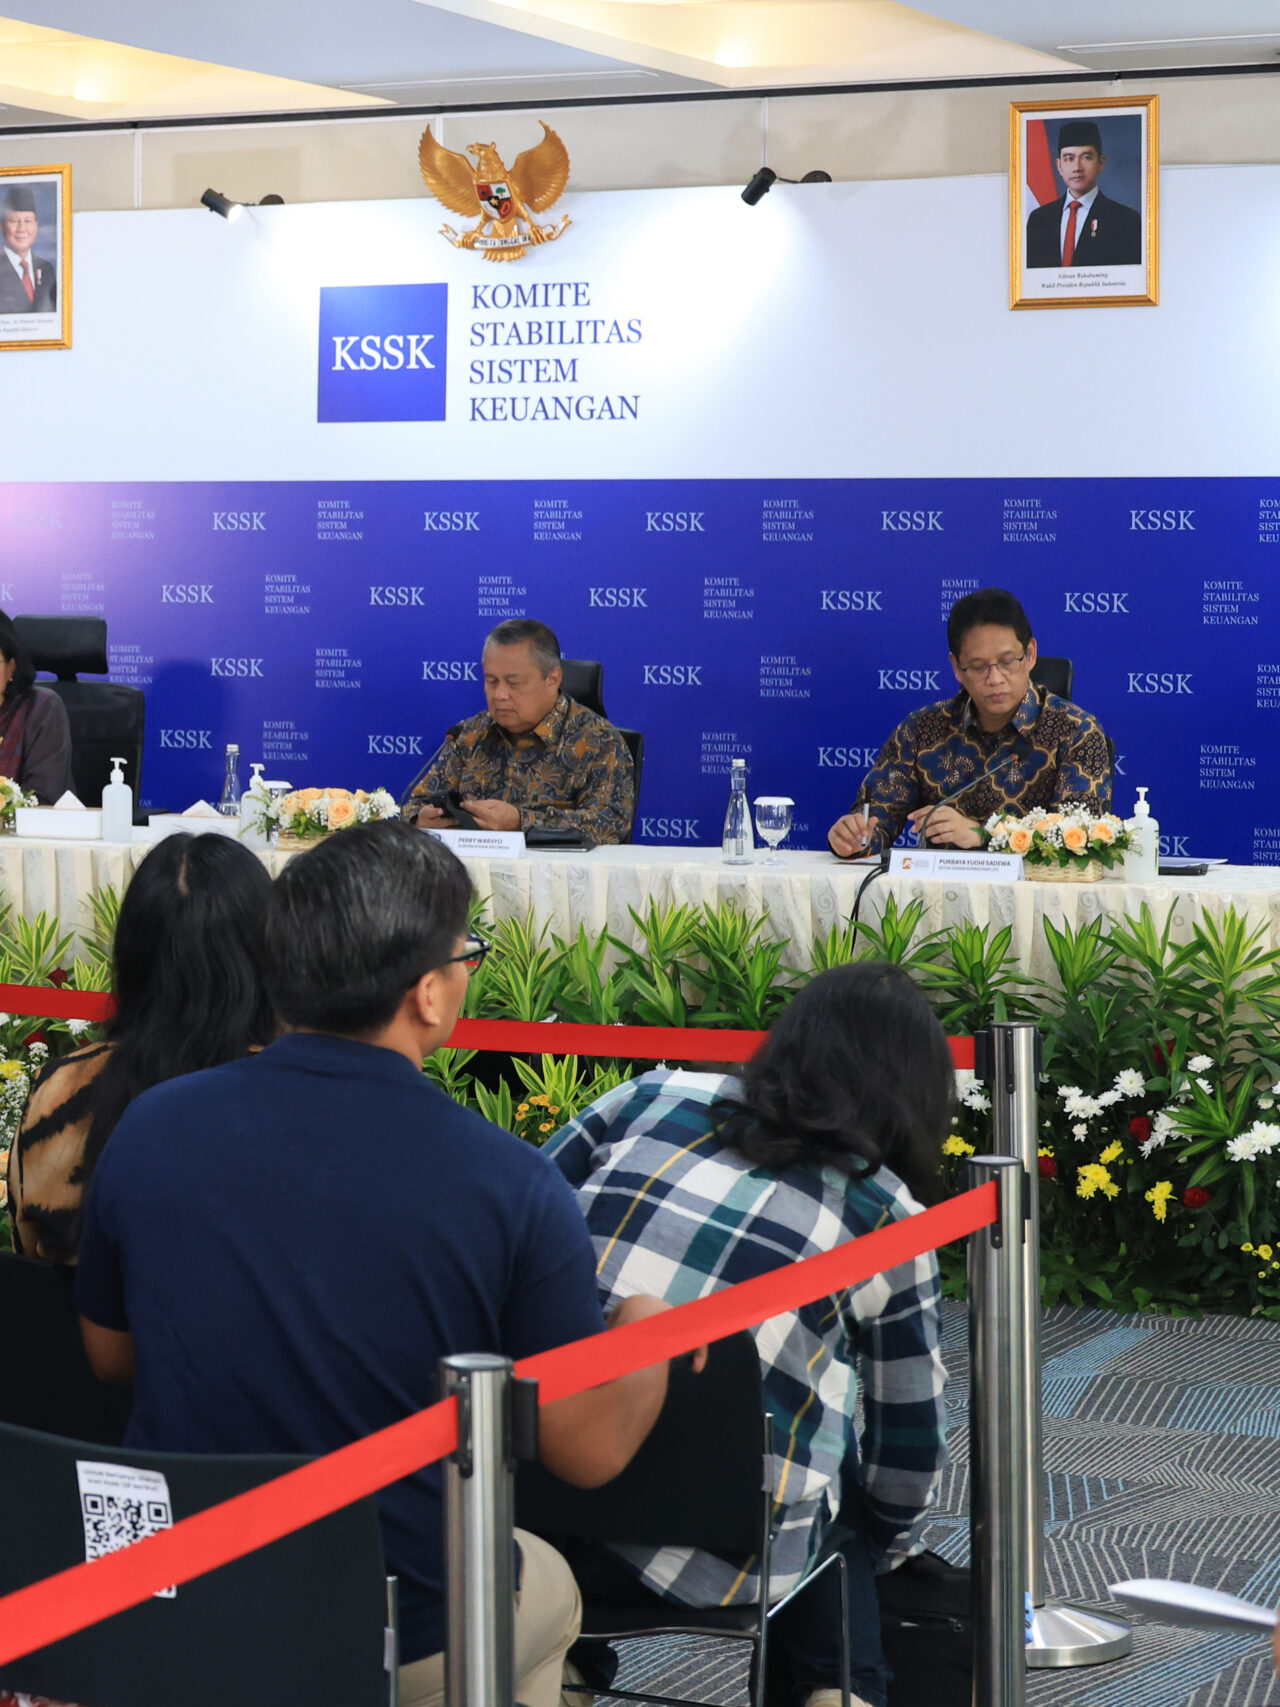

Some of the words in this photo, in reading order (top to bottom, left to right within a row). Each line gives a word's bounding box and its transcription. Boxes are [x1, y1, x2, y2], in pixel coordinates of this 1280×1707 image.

[472, 283, 591, 308] KOMITE
[470, 320, 642, 346] STABILITAS
[332, 335, 435, 370] KSSK
[469, 359, 578, 384] SISTEM
[470, 396, 640, 421] KEUANGAN
[317, 500, 351, 509] KOMITE
[533, 499, 569, 509] KOMITE
[762, 499, 800, 509] KOMITE
[1003, 499, 1042, 508] KOMITE
[317, 510, 365, 520] STABILITAS
[533, 510, 584, 520] STABILITAS
[761, 510, 815, 519] STABILITAS
[1002, 510, 1058, 519] STABILITAS
[211, 512, 267, 531] KSSK
[316, 520, 348, 530] SISTEM
[422, 511, 481, 531] KSSK
[644, 512, 707, 532] KSSK
[880, 510, 945, 531] KSSK
[1128, 510, 1197, 530] KSSK
[532, 521, 566, 530] SISTEM
[761, 521, 796, 531] SISTEM
[1002, 521, 1038, 531] SISTEM
[317, 531, 364, 541] KEUANGAN
[533, 531, 583, 541] KEUANGAN
[762, 532, 814, 542] KEUANGAN
[1002, 533, 1057, 542] KEUANGAN
[264, 573, 298, 583] KOMITE
[478, 575, 513, 585] KOMITE
[703, 577, 740, 586] KOMITE
[941, 579, 979, 588] KOMITE
[1203, 581, 1244, 590] KOMITE
[160, 585, 215, 603] KSSK
[264, 584, 312, 594] STABILITAS
[477, 586, 527, 595] STABILITAS
[703, 588, 755, 597] STABILITAS
[264, 594, 295, 604] SISTEM
[368, 586, 427, 606] KSSK
[588, 587, 649, 608] KSSK
[819, 590, 884, 611] KSSK
[1202, 591, 1260, 602] STABILITAS
[477, 597, 510, 606] SISTEM
[702, 599, 736, 608] SISTEM
[1063, 592, 1130, 613] KSSK
[264, 605, 312, 614] KEUANGAN
[477, 607, 526, 617] KEUANGAN
[1202, 604, 1239, 613] SISTEM
[703, 610, 754, 619] KEUANGAN
[1202, 616, 1259, 625] KEUANGAN
[315, 648, 349, 657] KOMITE
[314, 658, 363, 667] STABILITAS
[760, 656, 797, 665] KOMITE
[209, 658, 265, 677] KSSK
[420, 661, 479, 681] KSSK
[759, 666, 812, 676] STABILITAS
[314, 668, 345, 678] SISTEM
[642, 664, 703, 686] KSSK
[314, 679, 361, 689] KEUANGAN
[759, 677, 793, 687] SISTEM
[877, 669, 942, 690] KSSK
[1126, 672, 1195, 694] KSSK
[759, 689, 811, 698] KEUANGAN
[159, 729, 213, 749] KSSK
[701, 732, 738, 741] KOMITE
[367, 735, 424, 755] KSSK
[700, 743, 753, 753] STABILITAS
[1200, 744, 1240, 754] KOMITE
[817, 746, 881, 767] KSSK
[1199, 756, 1257, 766] STABILITAS
[1199, 768, 1236, 777] SISTEM
[1199, 779, 1256, 789] KEUANGAN
[640, 818, 701, 838] KSSK
